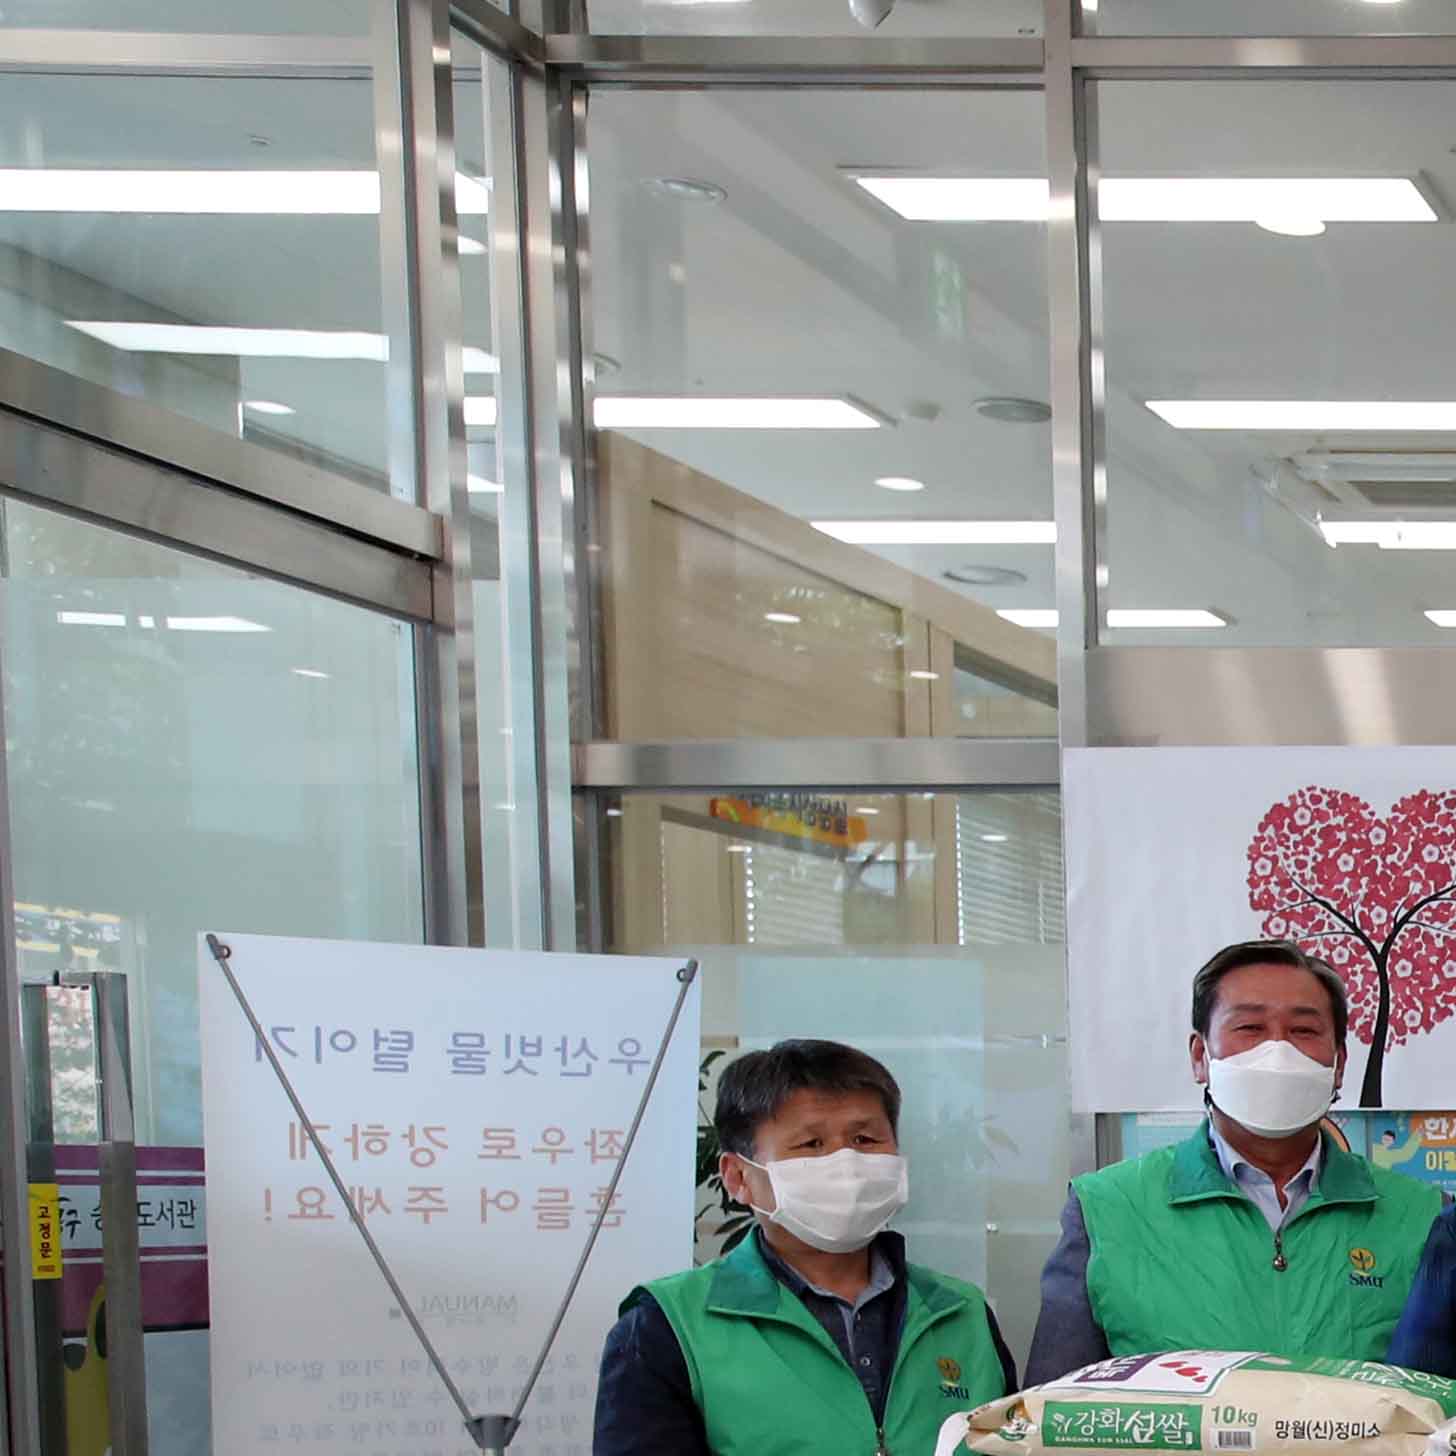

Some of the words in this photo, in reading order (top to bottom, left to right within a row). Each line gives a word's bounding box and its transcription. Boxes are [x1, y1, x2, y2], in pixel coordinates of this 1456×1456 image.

[1073, 1405, 1188, 1448] 강화섬쌀
[1210, 1404, 1259, 1427] 10kg
[1274, 1418, 1383, 1441] 망월(신)정미소
